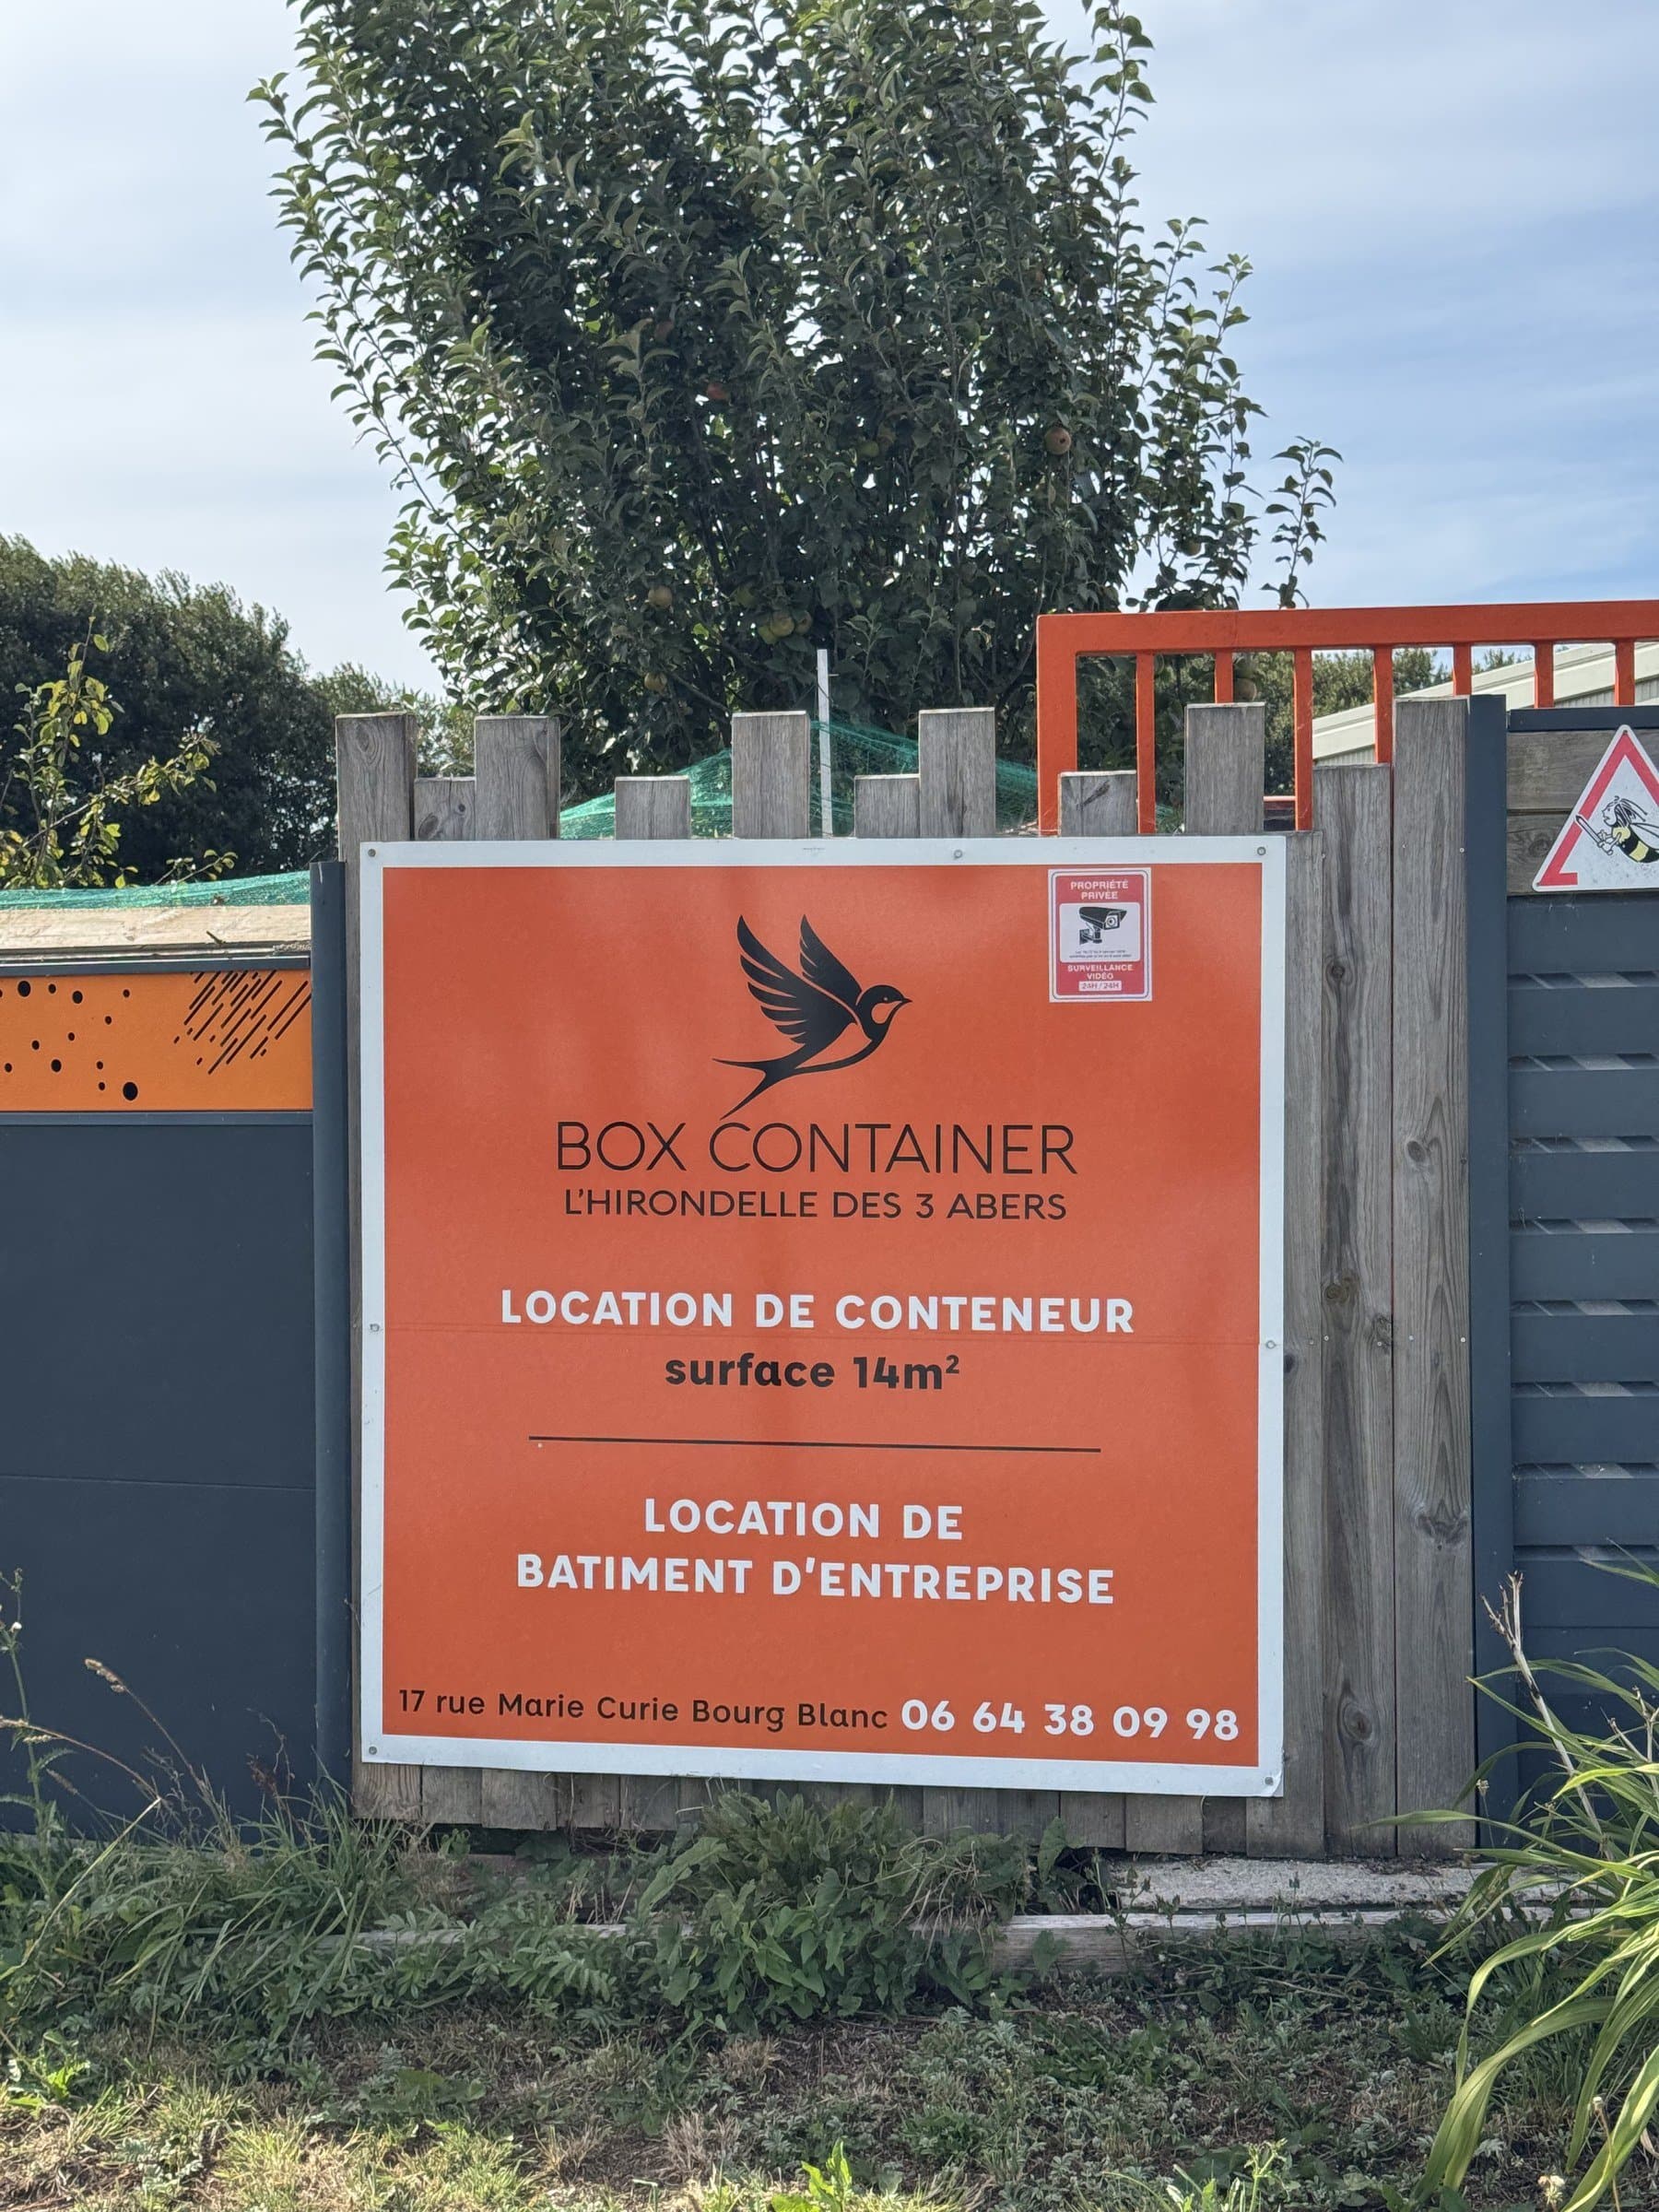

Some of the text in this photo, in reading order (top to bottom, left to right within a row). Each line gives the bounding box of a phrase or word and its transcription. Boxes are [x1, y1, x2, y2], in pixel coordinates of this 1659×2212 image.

[1070, 879, 1128, 890] PROPRIÉTÉ
[1081, 890, 1118, 900] PRIVÉE
[1067, 964, 1133, 972] SURVEILLANCE
[557, 1121, 1077, 1174] BOX CONTAINER
[565, 1188, 1066, 1220] L'HIRONDELLE DES 3 ABERS
[501, 1289, 1134, 1334] LOCATION DE CONTENEUR
[665, 1352, 835, 1388] surface
[645, 1498, 962, 1540] LOCATION DE
[517, 1553, 1114, 1605] BATIMENT D'ENTREPRISE
[399, 1688, 1239, 1741] 17 rue Marie Curie Bourg Blanc 06 64 38 09 98
